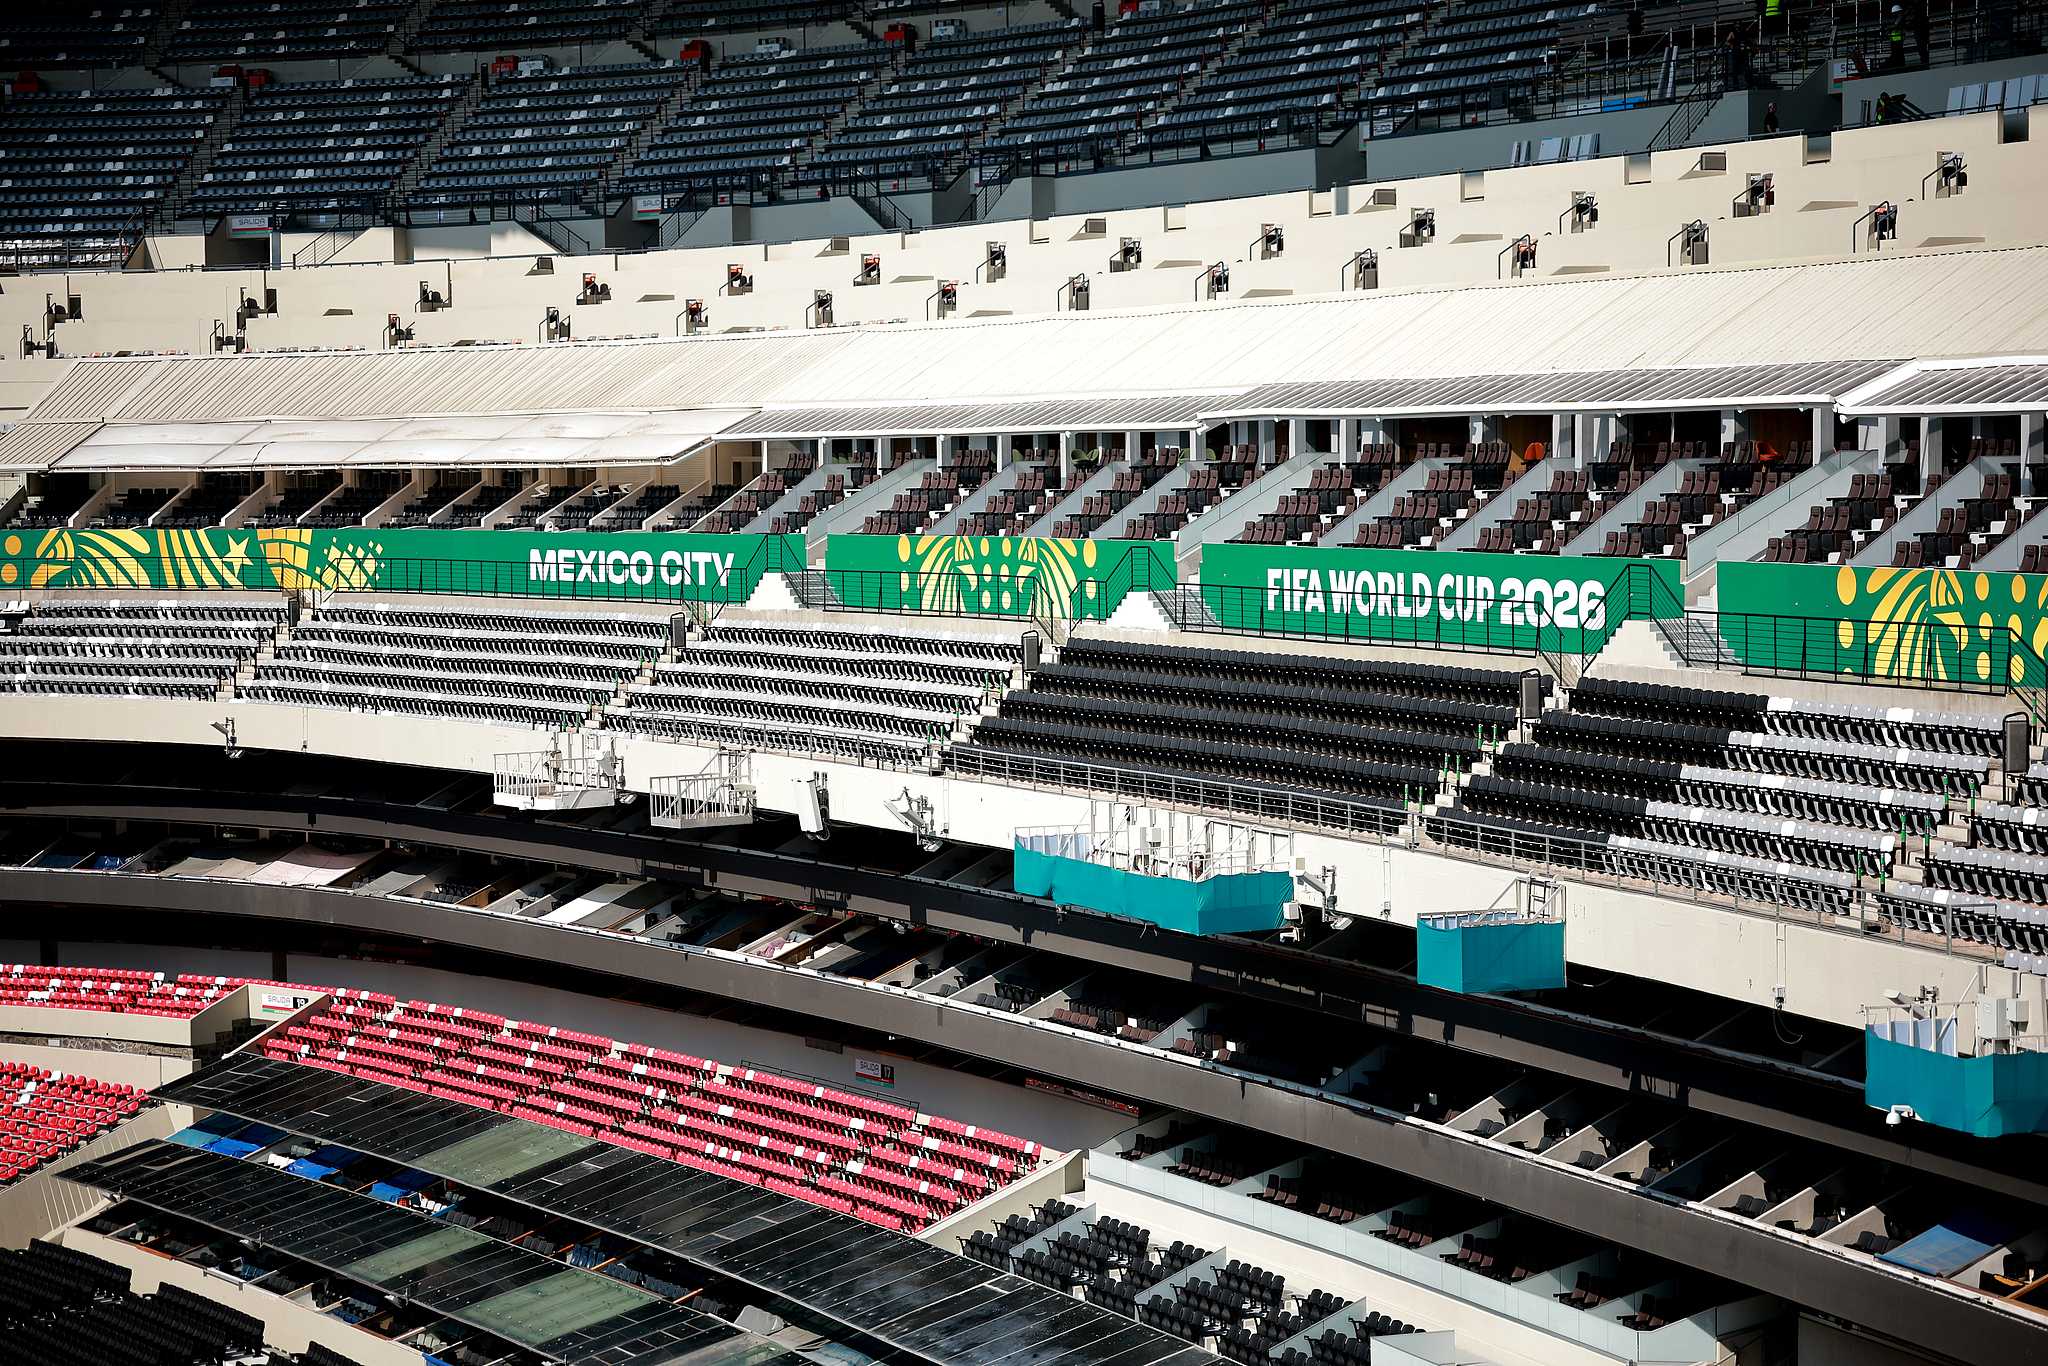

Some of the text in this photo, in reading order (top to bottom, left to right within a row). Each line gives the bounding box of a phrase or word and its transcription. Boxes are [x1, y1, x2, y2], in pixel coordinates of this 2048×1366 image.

[238, 217, 266, 225] SALIDA
[529, 548, 735, 587] MEXICO CITY
[1266, 567, 1606, 631] FIFA WORLD CUP 2026
[860, 1060, 880, 1073] SALIDA
